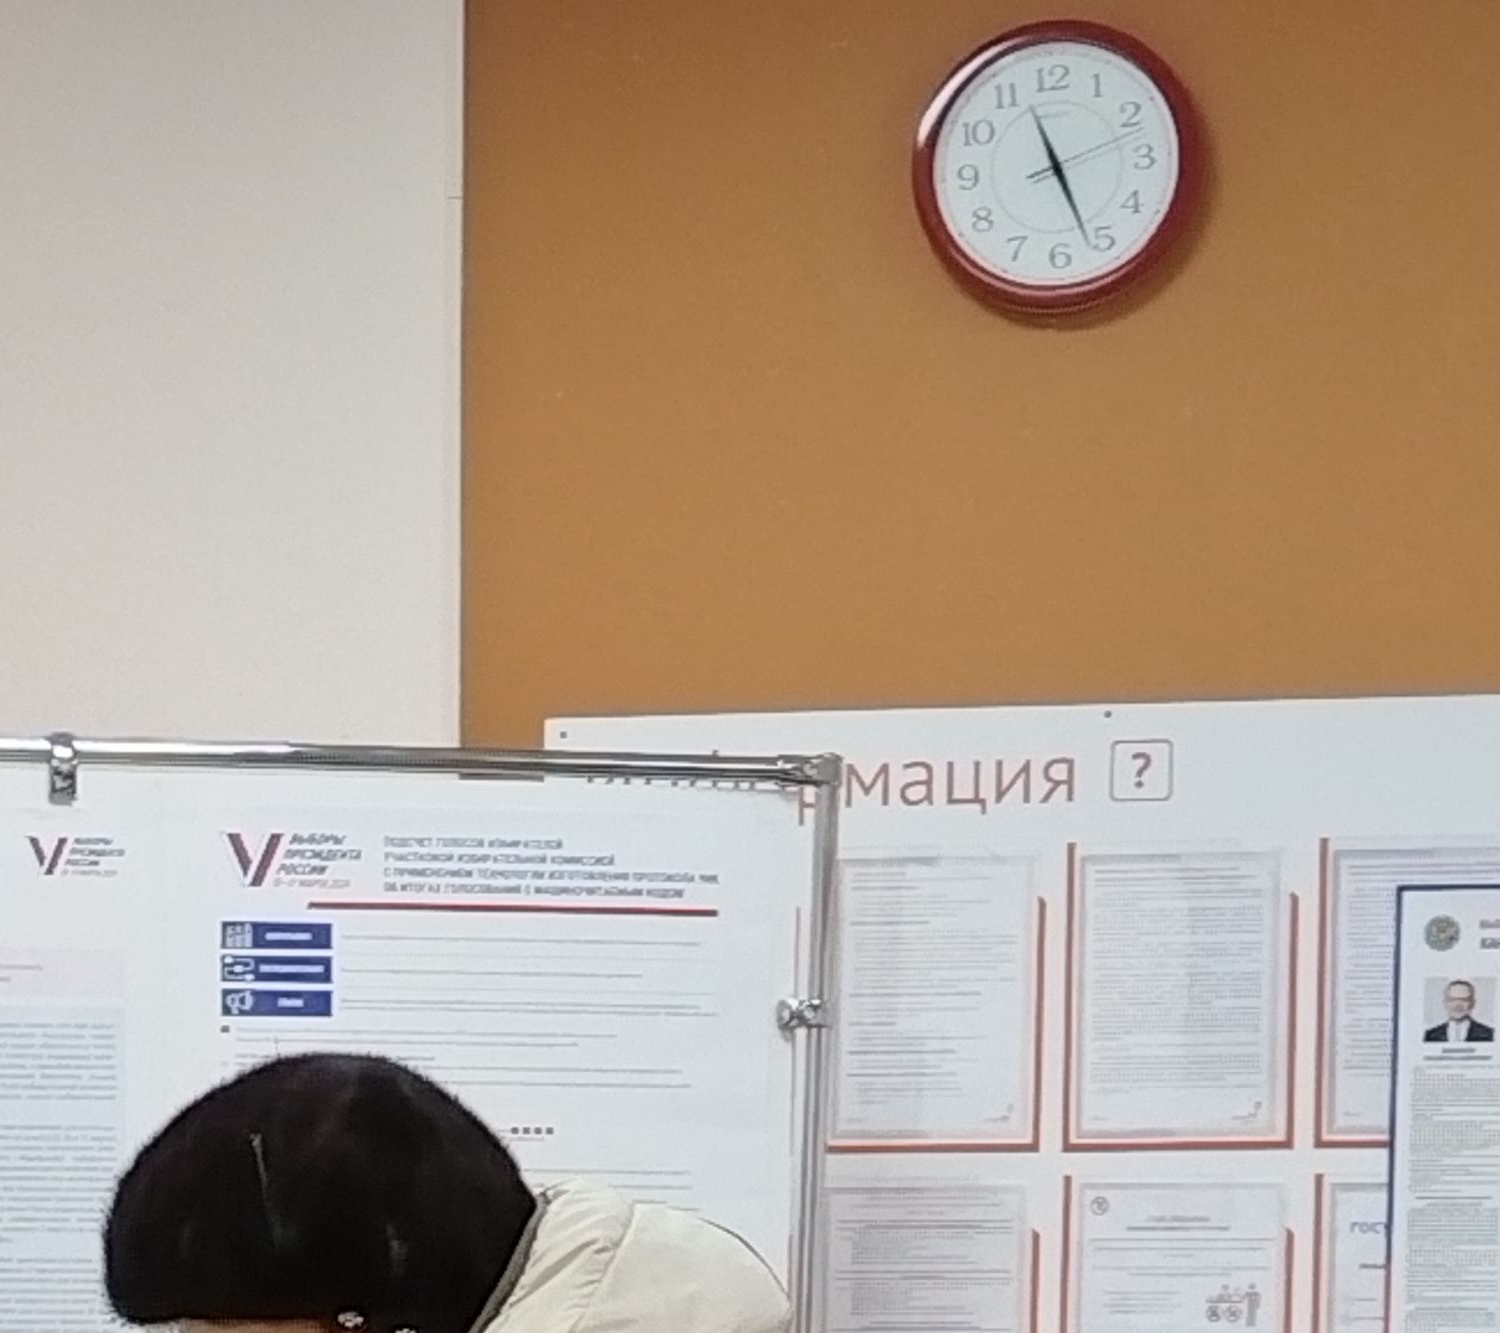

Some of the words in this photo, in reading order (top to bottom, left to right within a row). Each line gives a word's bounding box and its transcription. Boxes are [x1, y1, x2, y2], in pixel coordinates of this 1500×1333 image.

[1035, 64, 1071, 93] 12
[1091, 73, 1104, 98] 1
[994, 82, 1020, 109] 11
[1119, 101, 1142, 128] 2
[962, 119, 996, 147] 10
[1133, 144, 1157, 170] 3
[956, 164, 980, 191] 9
[1121, 189, 1144, 214] 4
[971, 206, 994, 233] 8
[1006, 236, 1029, 262] 7
[1092, 225, 1116, 252] 5
[1049, 243, 1073, 269] 6
[794, 757, 1076, 826] мация
